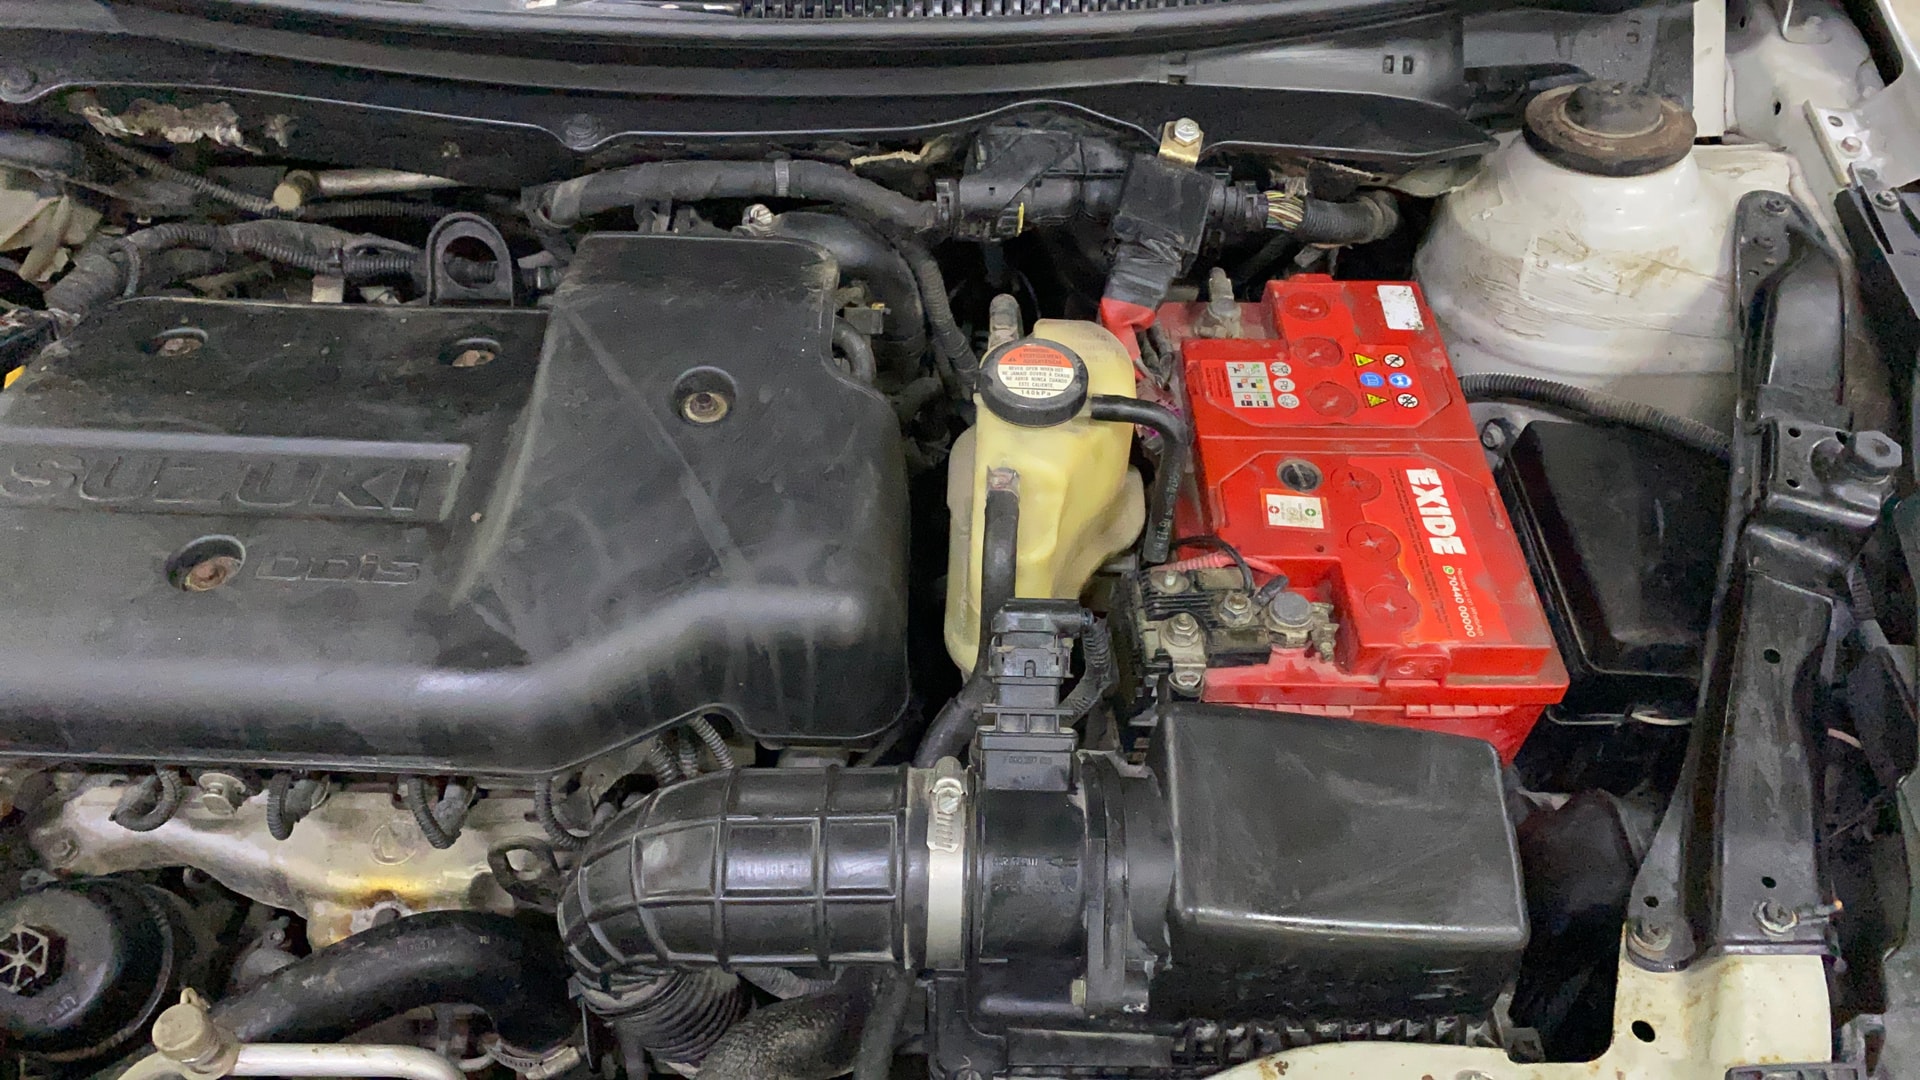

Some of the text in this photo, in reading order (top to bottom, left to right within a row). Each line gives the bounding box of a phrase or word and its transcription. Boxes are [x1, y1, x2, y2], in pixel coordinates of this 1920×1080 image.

[1405, 468, 1467, 555] EXIDE
[1448, 574, 1476, 638] 70440 00000
